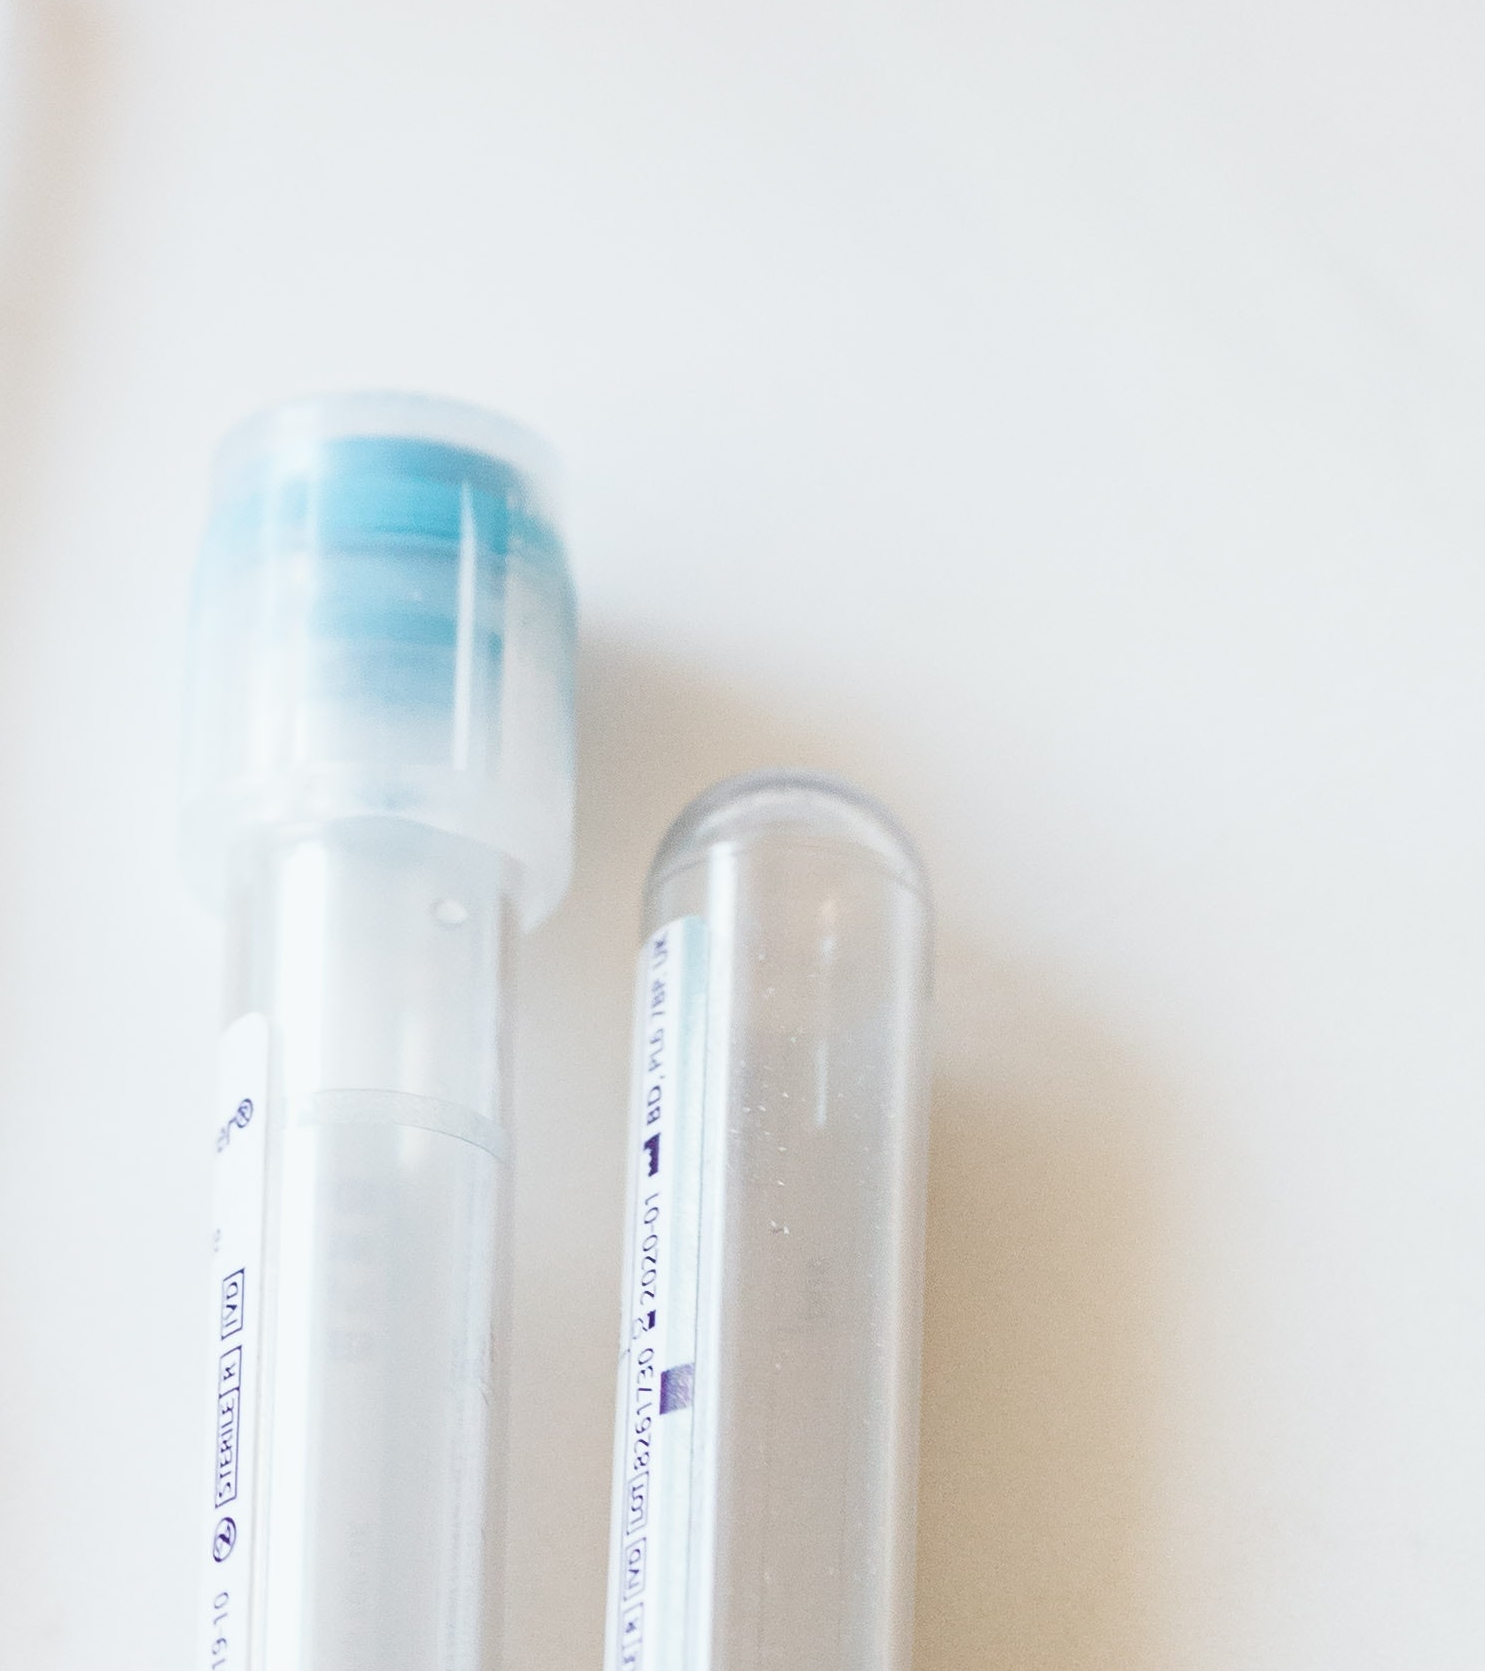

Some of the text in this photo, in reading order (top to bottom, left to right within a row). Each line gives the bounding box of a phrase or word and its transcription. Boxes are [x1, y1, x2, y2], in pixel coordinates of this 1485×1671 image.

[223, 1280, 240, 1329] IVD
[639, 1193, 660, 1306] 2020-01
[633, 1347, 655, 1471] 8261730
